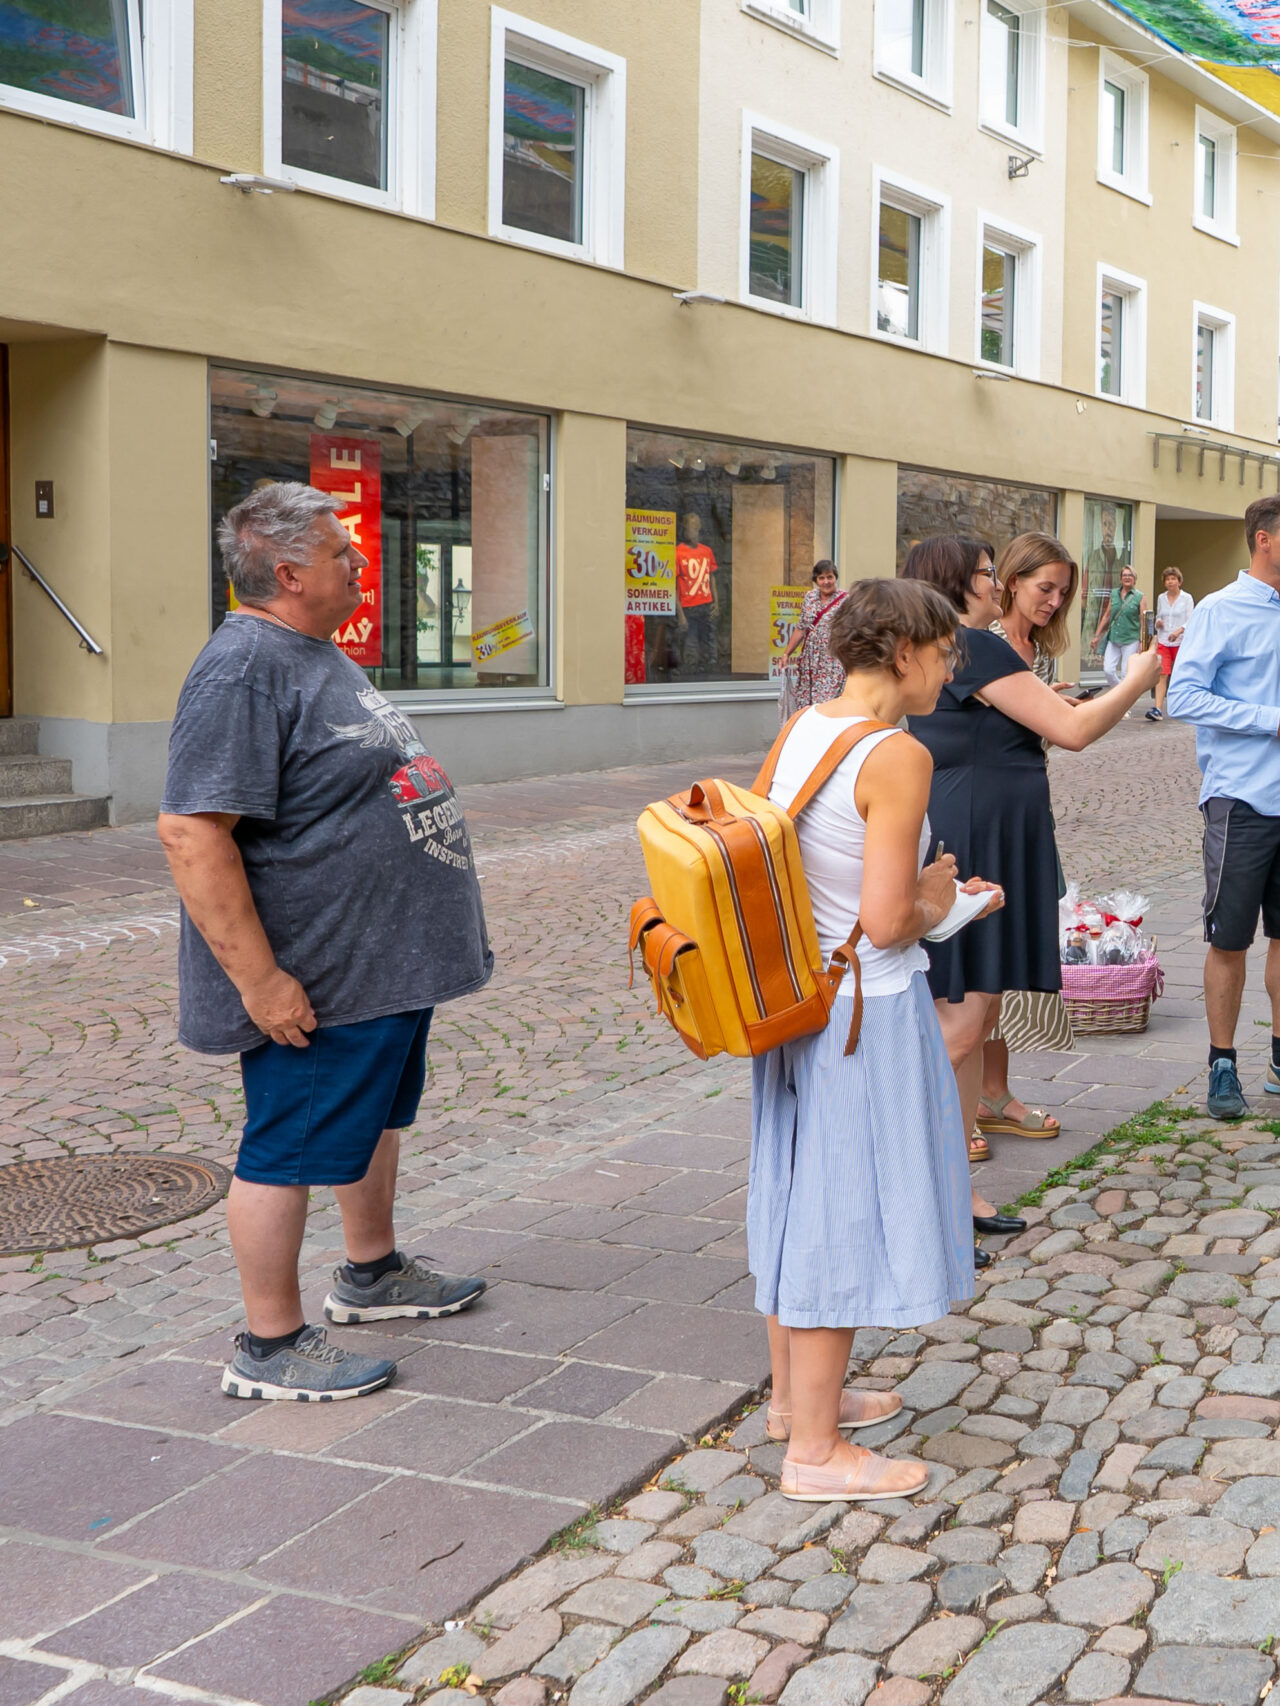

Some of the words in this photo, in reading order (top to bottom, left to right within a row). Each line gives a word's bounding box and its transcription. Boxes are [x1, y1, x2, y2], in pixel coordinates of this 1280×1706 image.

[330, 437, 362, 577] ALE
[625, 513, 674, 526] RÄUMUNGS-
[631, 526, 669, 537] VERKAUF
[626, 545, 673, 579] 30%
[626, 588, 673, 600] SOMMER-
[626, 601, 672, 612] ARTIKEL
